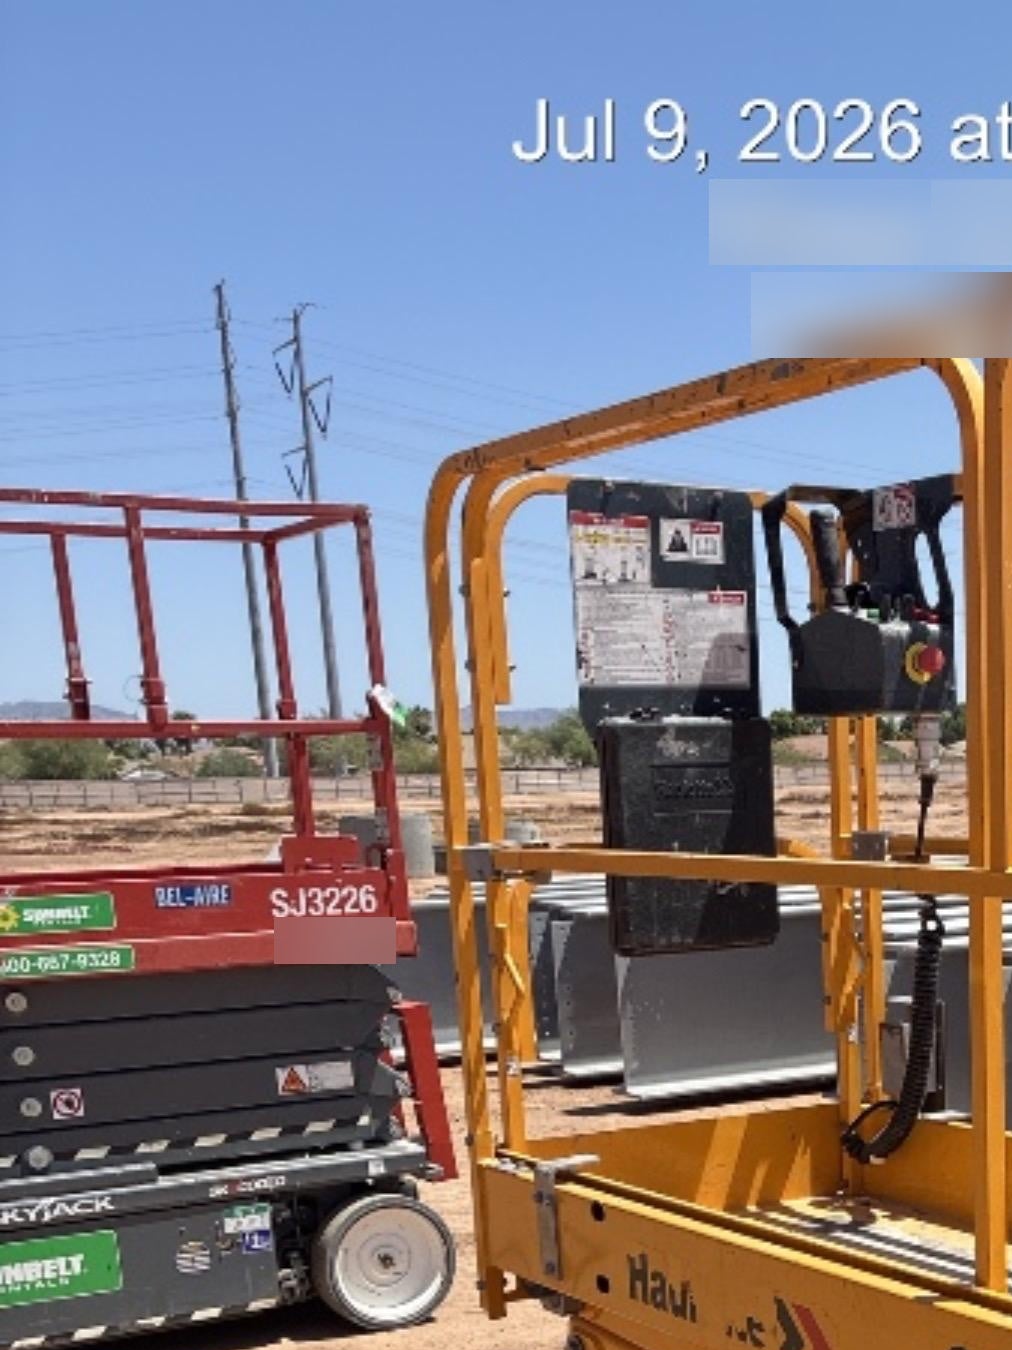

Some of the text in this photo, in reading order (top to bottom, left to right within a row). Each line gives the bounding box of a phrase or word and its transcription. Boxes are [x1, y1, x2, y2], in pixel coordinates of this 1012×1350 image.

[270, 885, 378, 918] SJ3226
[0, 1197, 116, 1225] KYJACK
[0, 1253, 86, 1285] NBELT
